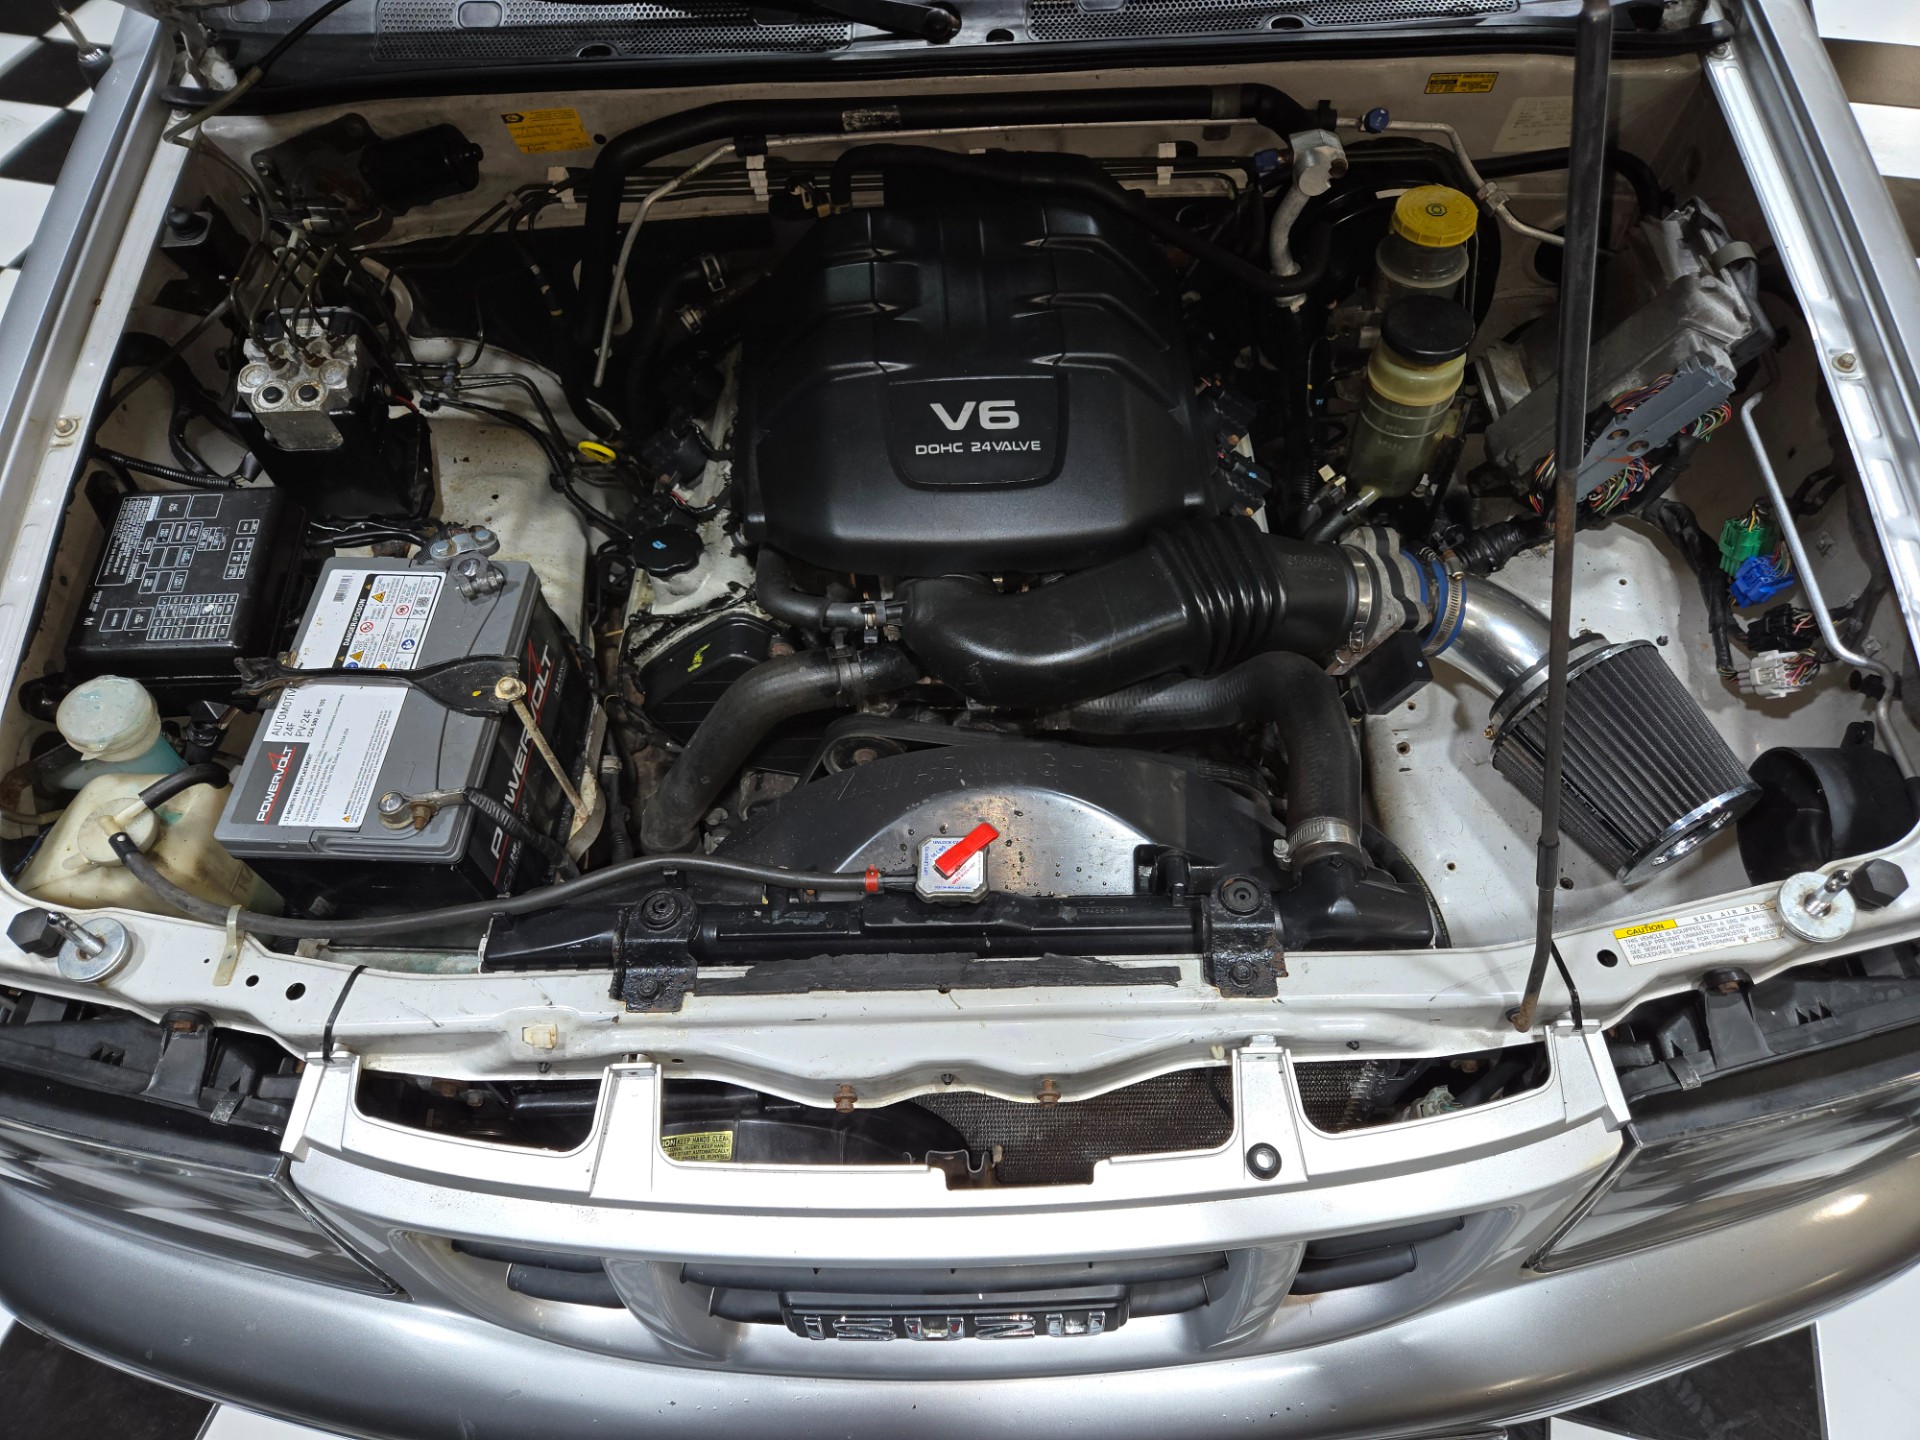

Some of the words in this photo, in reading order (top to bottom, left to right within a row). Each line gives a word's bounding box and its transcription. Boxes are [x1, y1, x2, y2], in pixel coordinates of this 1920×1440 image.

[930, 400, 1020, 430] V6
[915, 442, 963, 455] DOHC
[342, 598, 366, 645] DANGER/POISON
[283, 721, 295, 736] 24F
[297, 708, 313, 736] PV-24F
[306, 727, 314, 737] CCA
[490, 643, 552, 858] PWERVOLT
[296, 753, 313, 784] REPLACEMENT
[255, 745, 294, 822] POWERVOLT
[1625, 922, 1664, 935] CAUTION
[1639, 932, 1664, 941] VEHICLE
[1672, 925, 1701, 934] EQUIPPED
[1643, 943, 1667, 952] SERVICE
[1669, 938, 1694, 946] MANUAL
[1710, 928, 1746, 939] DIAGNOSTIC
[1653, 934, 1681, 943] PREVENT
[1682, 928, 1715, 938] UNWANTED
[1632, 948, 1671, 960] PROCEDURES
[1672, 943, 1696, 952] BEFORE
[1697, 936, 1735, 947] PERFORMING
[804, 1311, 1106, 1341] ISUZU
